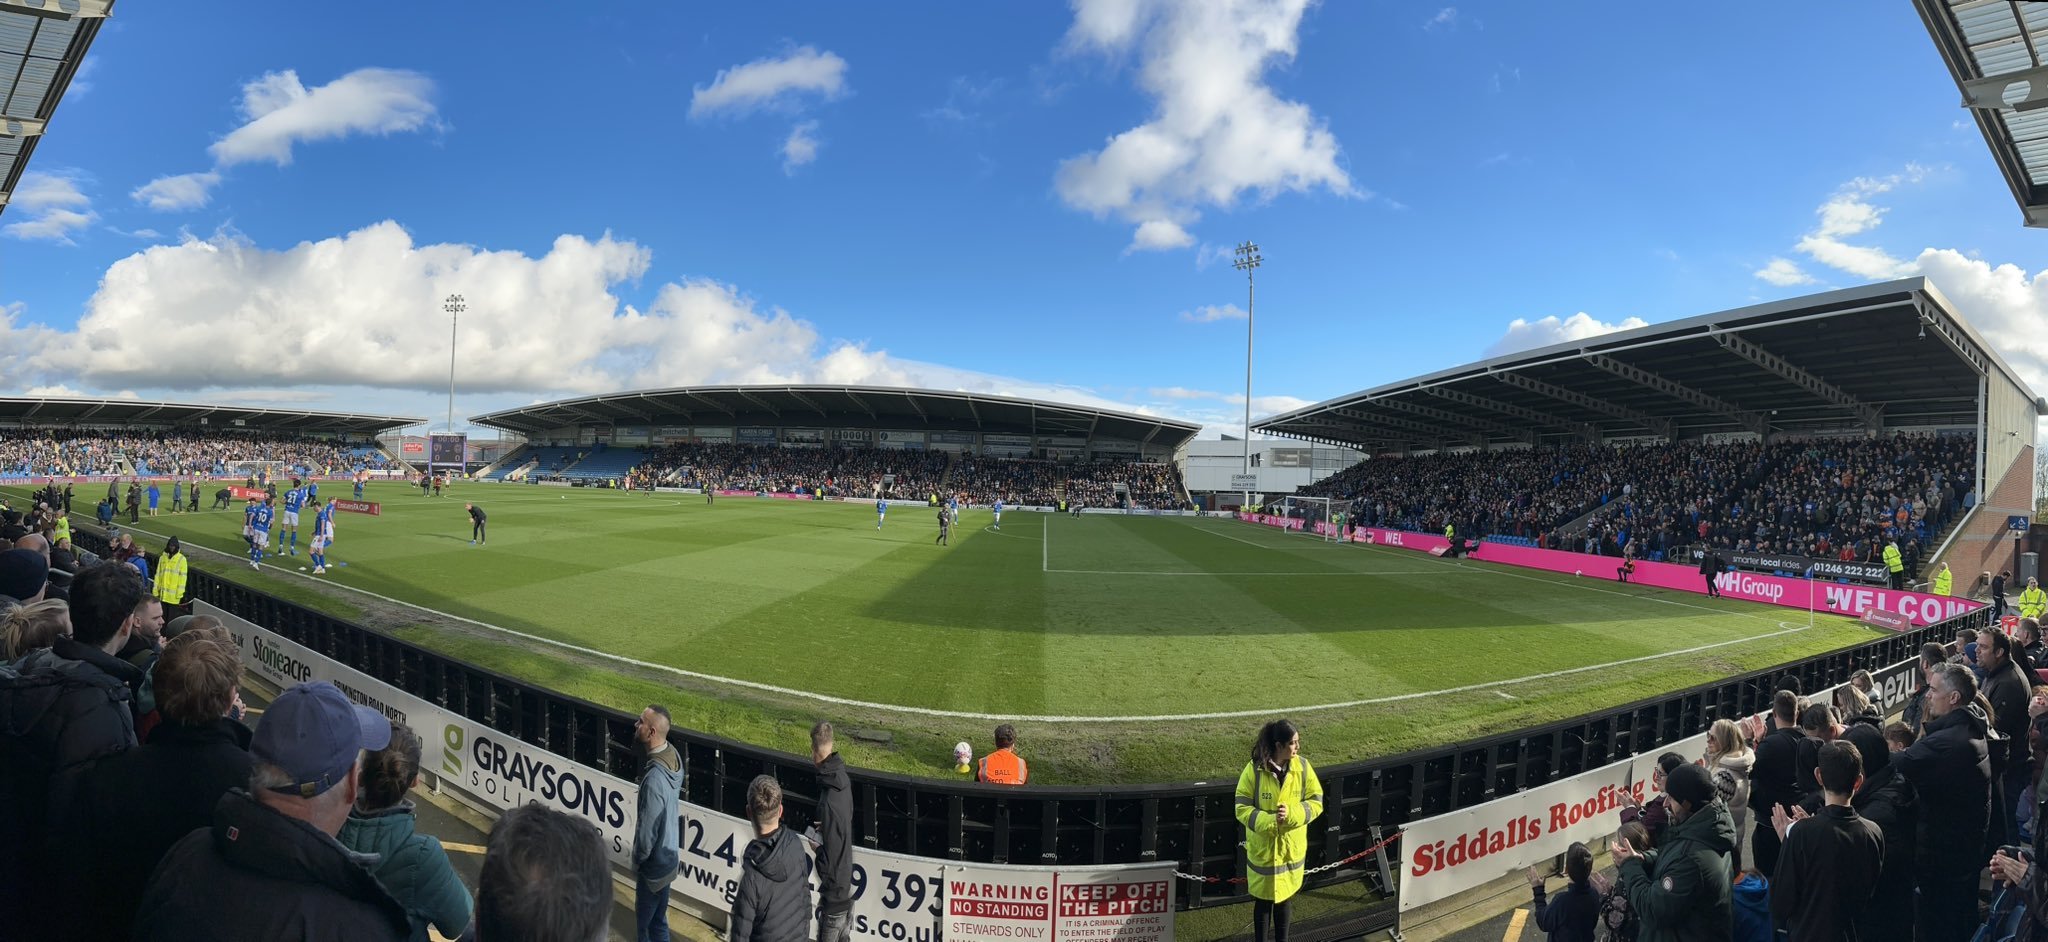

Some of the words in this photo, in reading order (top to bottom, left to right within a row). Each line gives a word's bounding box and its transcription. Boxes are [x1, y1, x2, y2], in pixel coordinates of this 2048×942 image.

[287, 494, 297, 504] 21
[258, 513, 267, 522] 10
[1385, 531, 1403, 545] WEL
[1732, 556, 1759, 566] smarter
[1760, 558, 1781, 567] local
[1781, 560, 1802, 569] rides.
[1814, 562, 1842, 574] 01246
[1845, 565, 1862, 576] 222
[1865, 567, 1883, 578] 222
[1713, 571, 1740, 592] MH
[1742, 576, 1783, 603] Group
[1826, 586, 1979, 624] WELCOM
[253, 636, 311, 682] Stoneacre
[368, 696, 384, 715] ROAD
[384, 704, 406, 724] NORTH
[473, 736, 624, 828] GRAYSONS
[1411, 816, 1541, 877] Siddalls
[882, 869, 943, 916] 393
[950, 881, 1048, 900] WARNING
[1062, 885, 1117, 900] KEEP
[1127, 882, 1166, 897] OFF
[954, 902, 972, 913] NO
[976, 903, 1044, 917] STANDING
[1062, 901, 1099, 915] THE
[1108, 898, 1165, 914] PITCH
[1126, 917, 1160, 925] OFFENCE
[952, 923, 1012, 936] STEWARDS
[1015, 926, 1044, 938] ONLY
